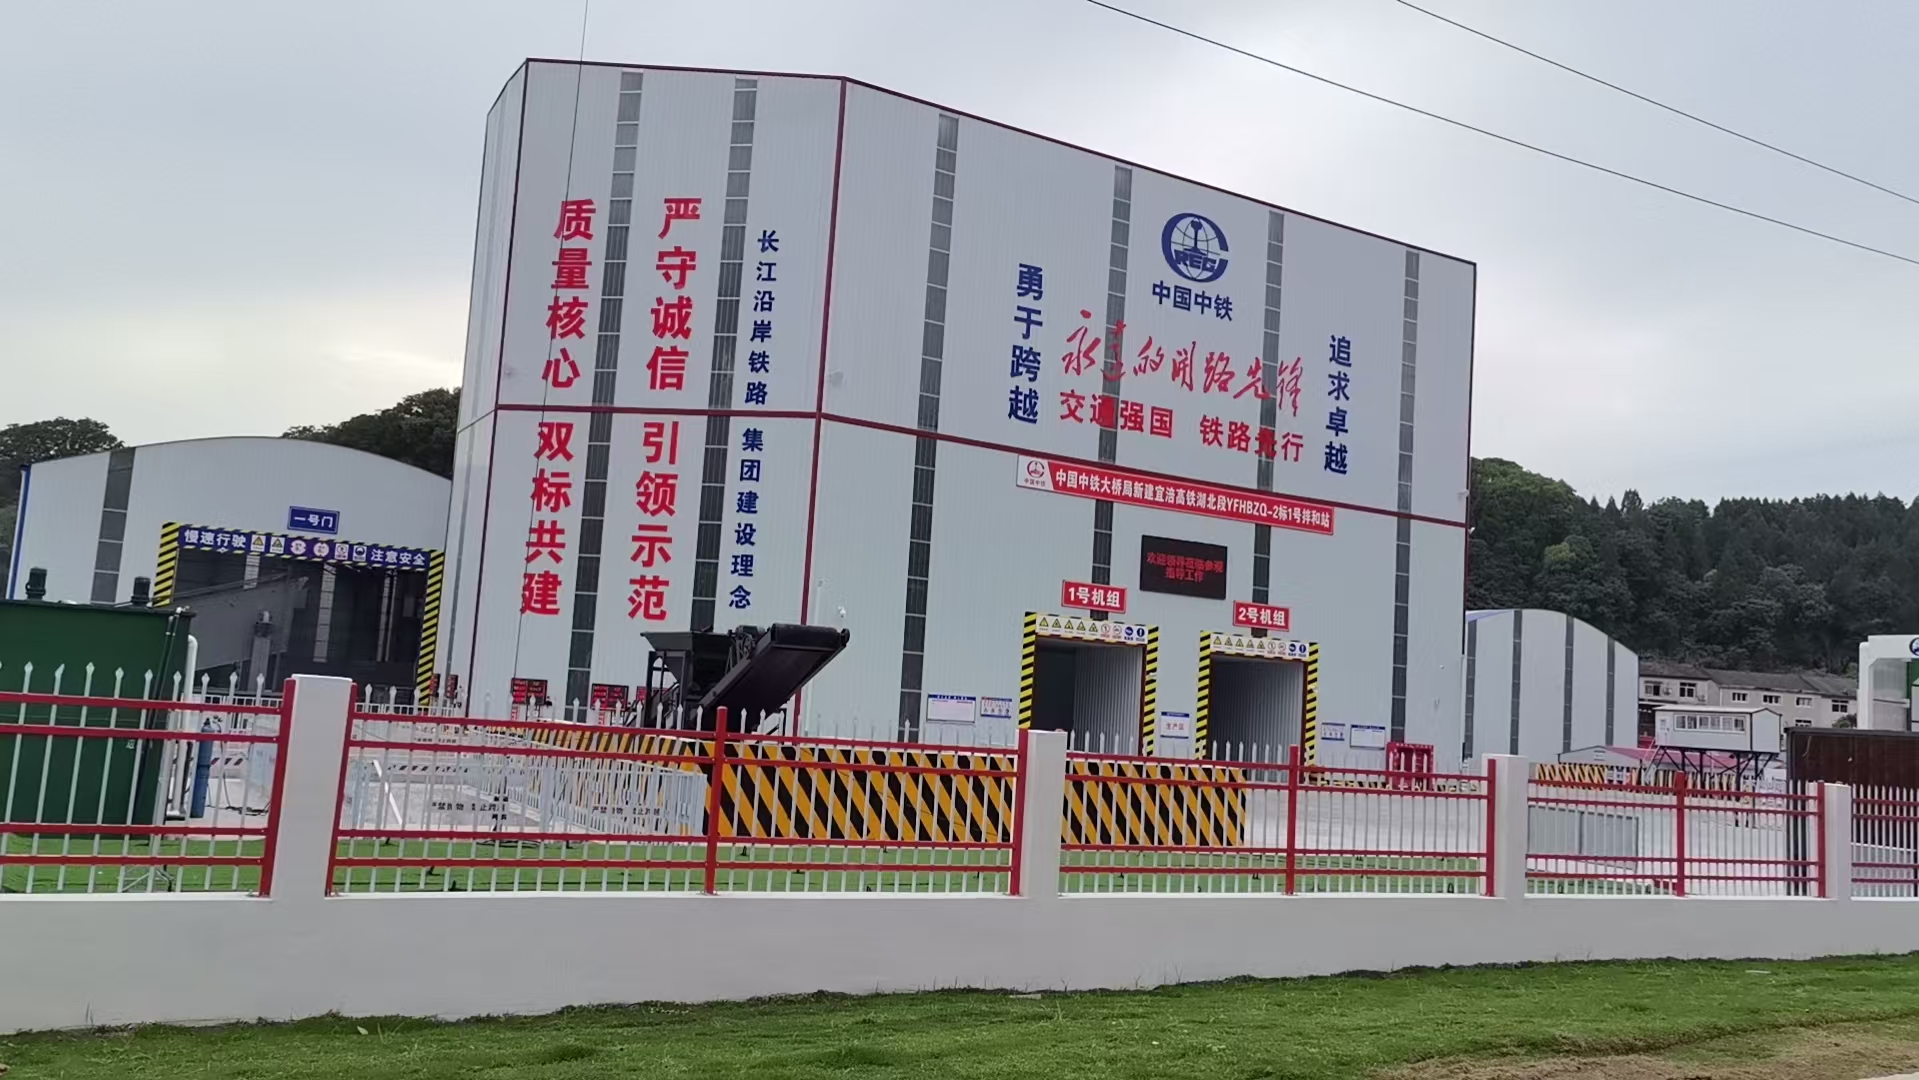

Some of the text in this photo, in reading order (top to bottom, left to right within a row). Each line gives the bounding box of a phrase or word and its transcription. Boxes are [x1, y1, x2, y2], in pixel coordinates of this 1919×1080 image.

[542, 199, 596, 389] 质量核心
[646, 198, 702, 391] 严守诚信
[745, 230, 779, 405] 长江沿岸铁路
[1008, 263, 1044, 424] 勇于跨越
[1152, 280, 1233, 321] 中国中铁
[1200, 415, 1304, 462] 铁路先行
[1324, 335, 1352, 475] 追求卓越
[184, 529, 247, 549] 慢速行驶
[294, 515, 334, 529] 一号门
[370, 548, 426, 566] 注意安全
[520, 421, 574, 616] 双标共建
[628, 421, 679, 621] 引领示范
[729, 428, 764, 609] 集团建设理念
[1068, 586, 1121, 609] 1号机组
[1238, 607, 1286, 627] 2号机组
